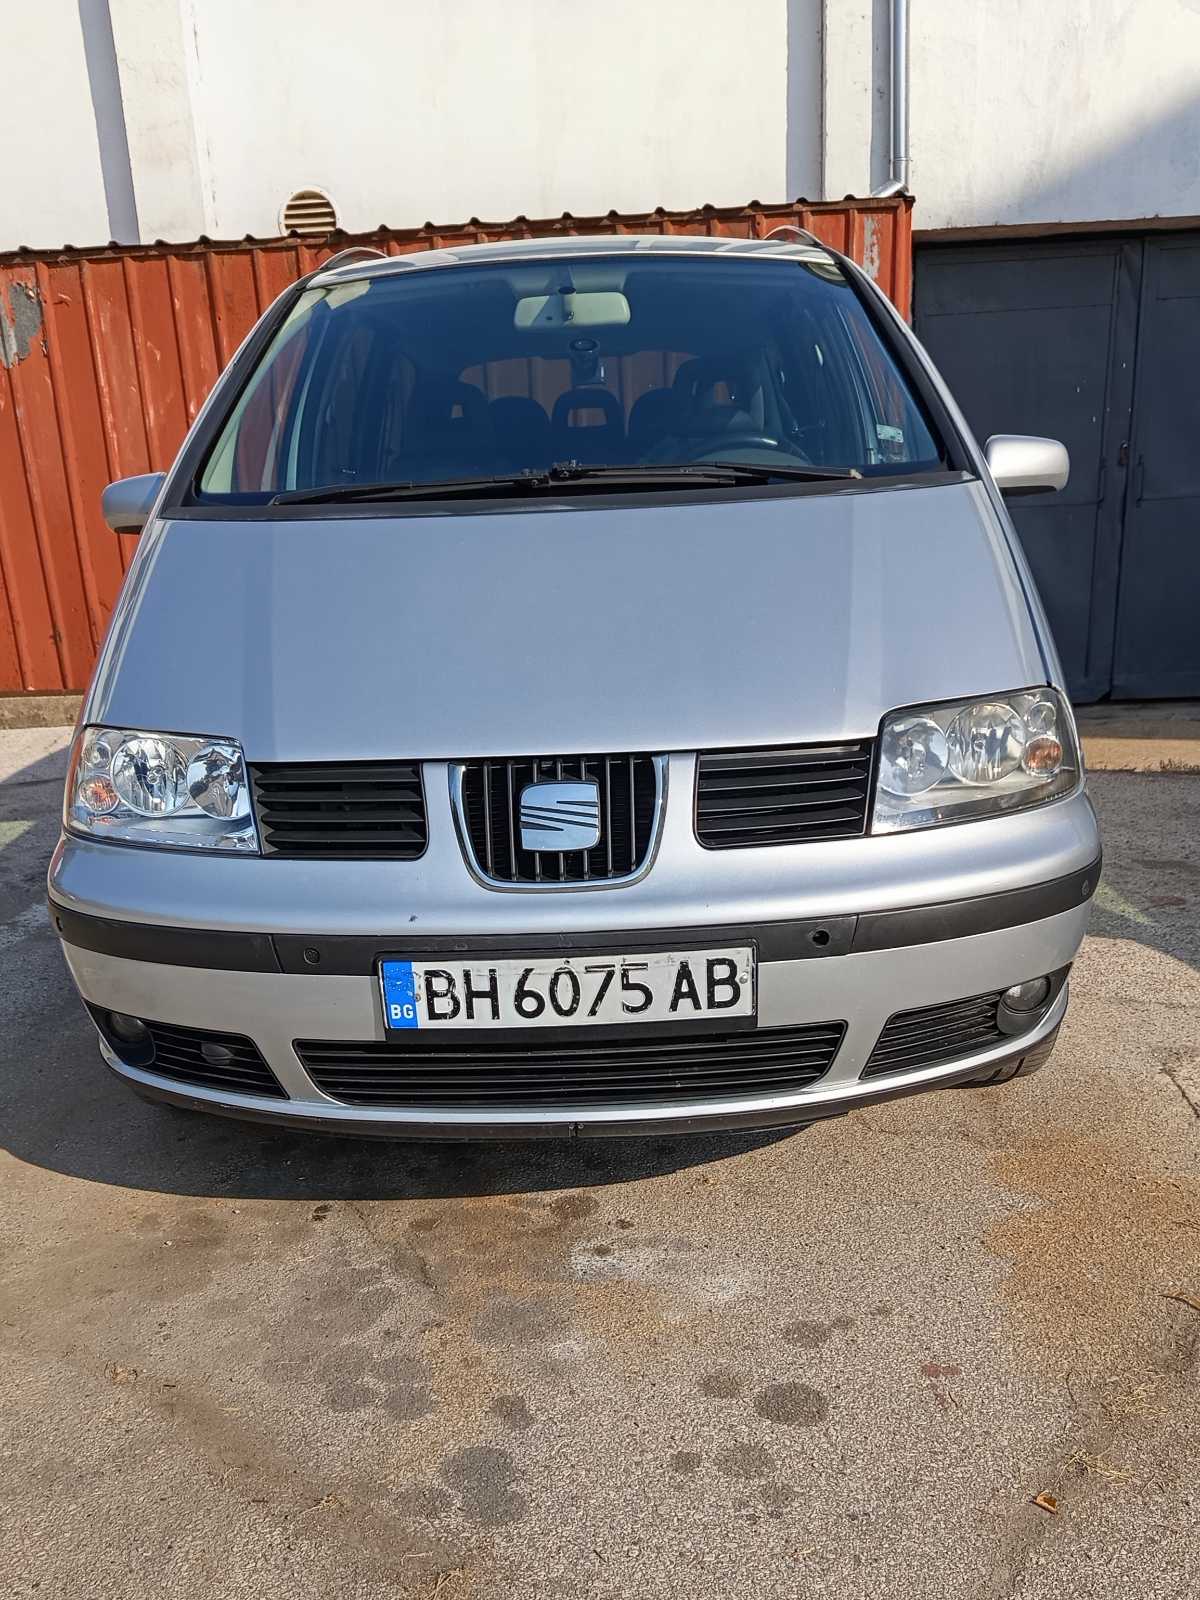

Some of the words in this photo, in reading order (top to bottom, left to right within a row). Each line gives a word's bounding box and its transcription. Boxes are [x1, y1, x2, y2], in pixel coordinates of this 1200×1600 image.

[424, 968, 501, 1020] BH
[513, 962, 654, 1019] 6075
[668, 957, 742, 1013] AB
[390, 1004, 414, 1020] BG
